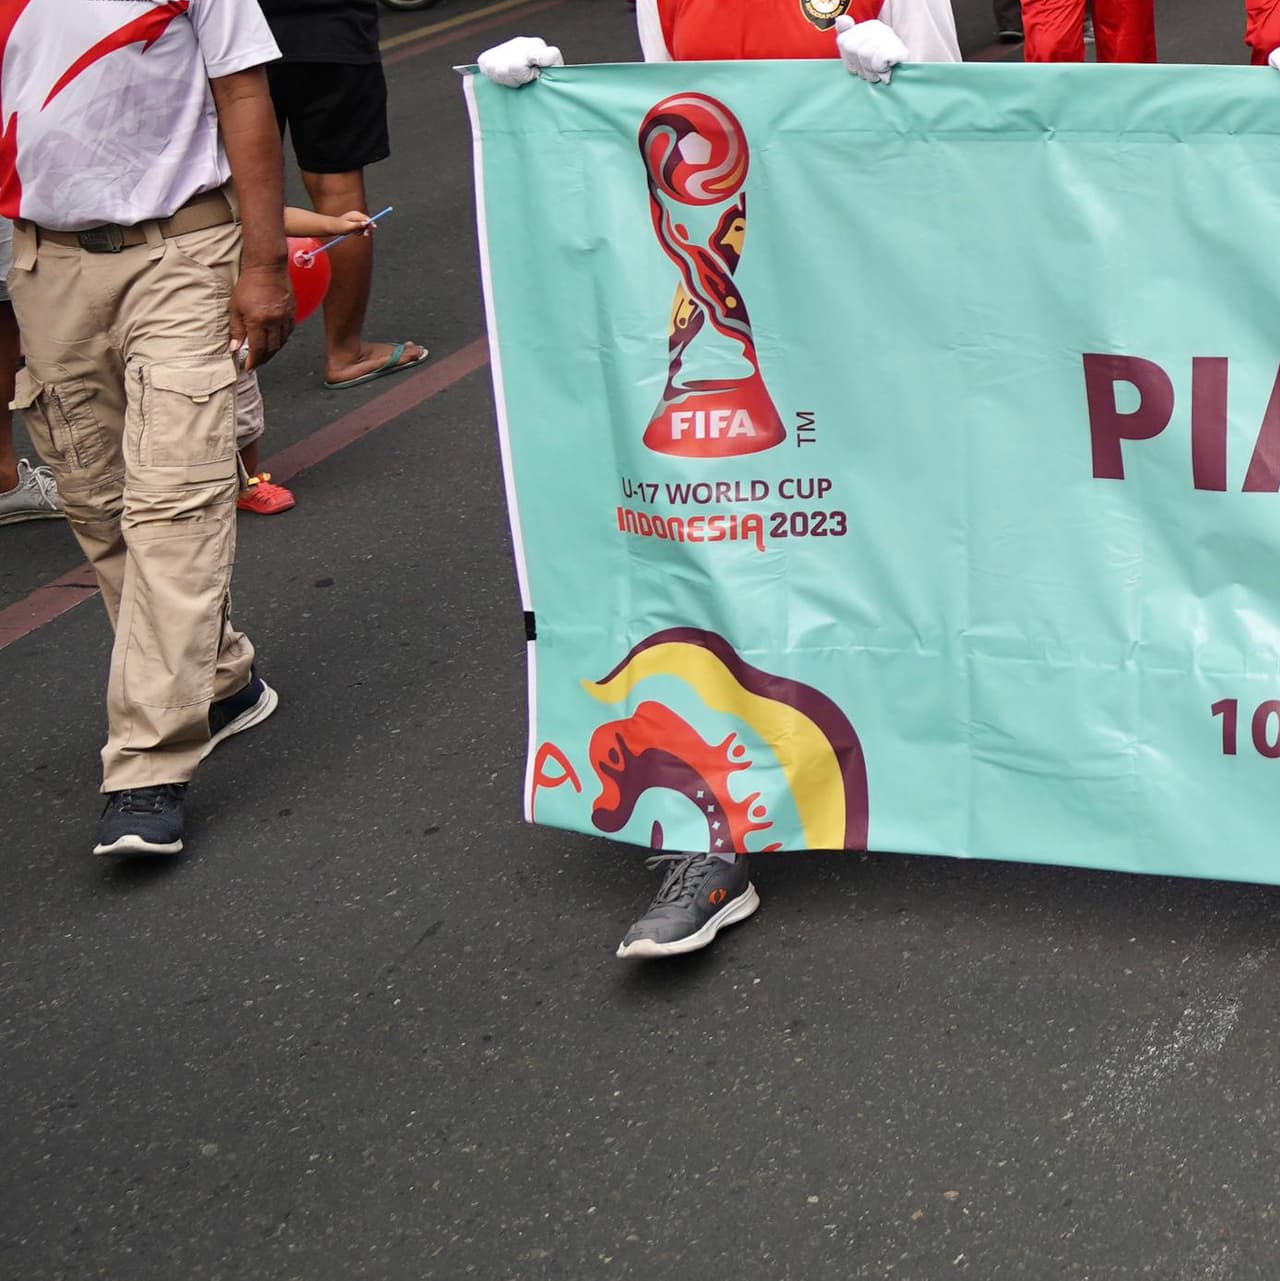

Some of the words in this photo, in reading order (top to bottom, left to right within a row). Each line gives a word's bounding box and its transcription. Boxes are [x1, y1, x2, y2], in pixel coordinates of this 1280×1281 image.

[671, 409, 756, 440] FIFA
[797, 411, 816, 448] TM
[622, 477, 659, 504] U-17
[665, 480, 769, 505] WORLD
[778, 478, 832, 500] CUP
[769, 511, 847, 538] 2023
